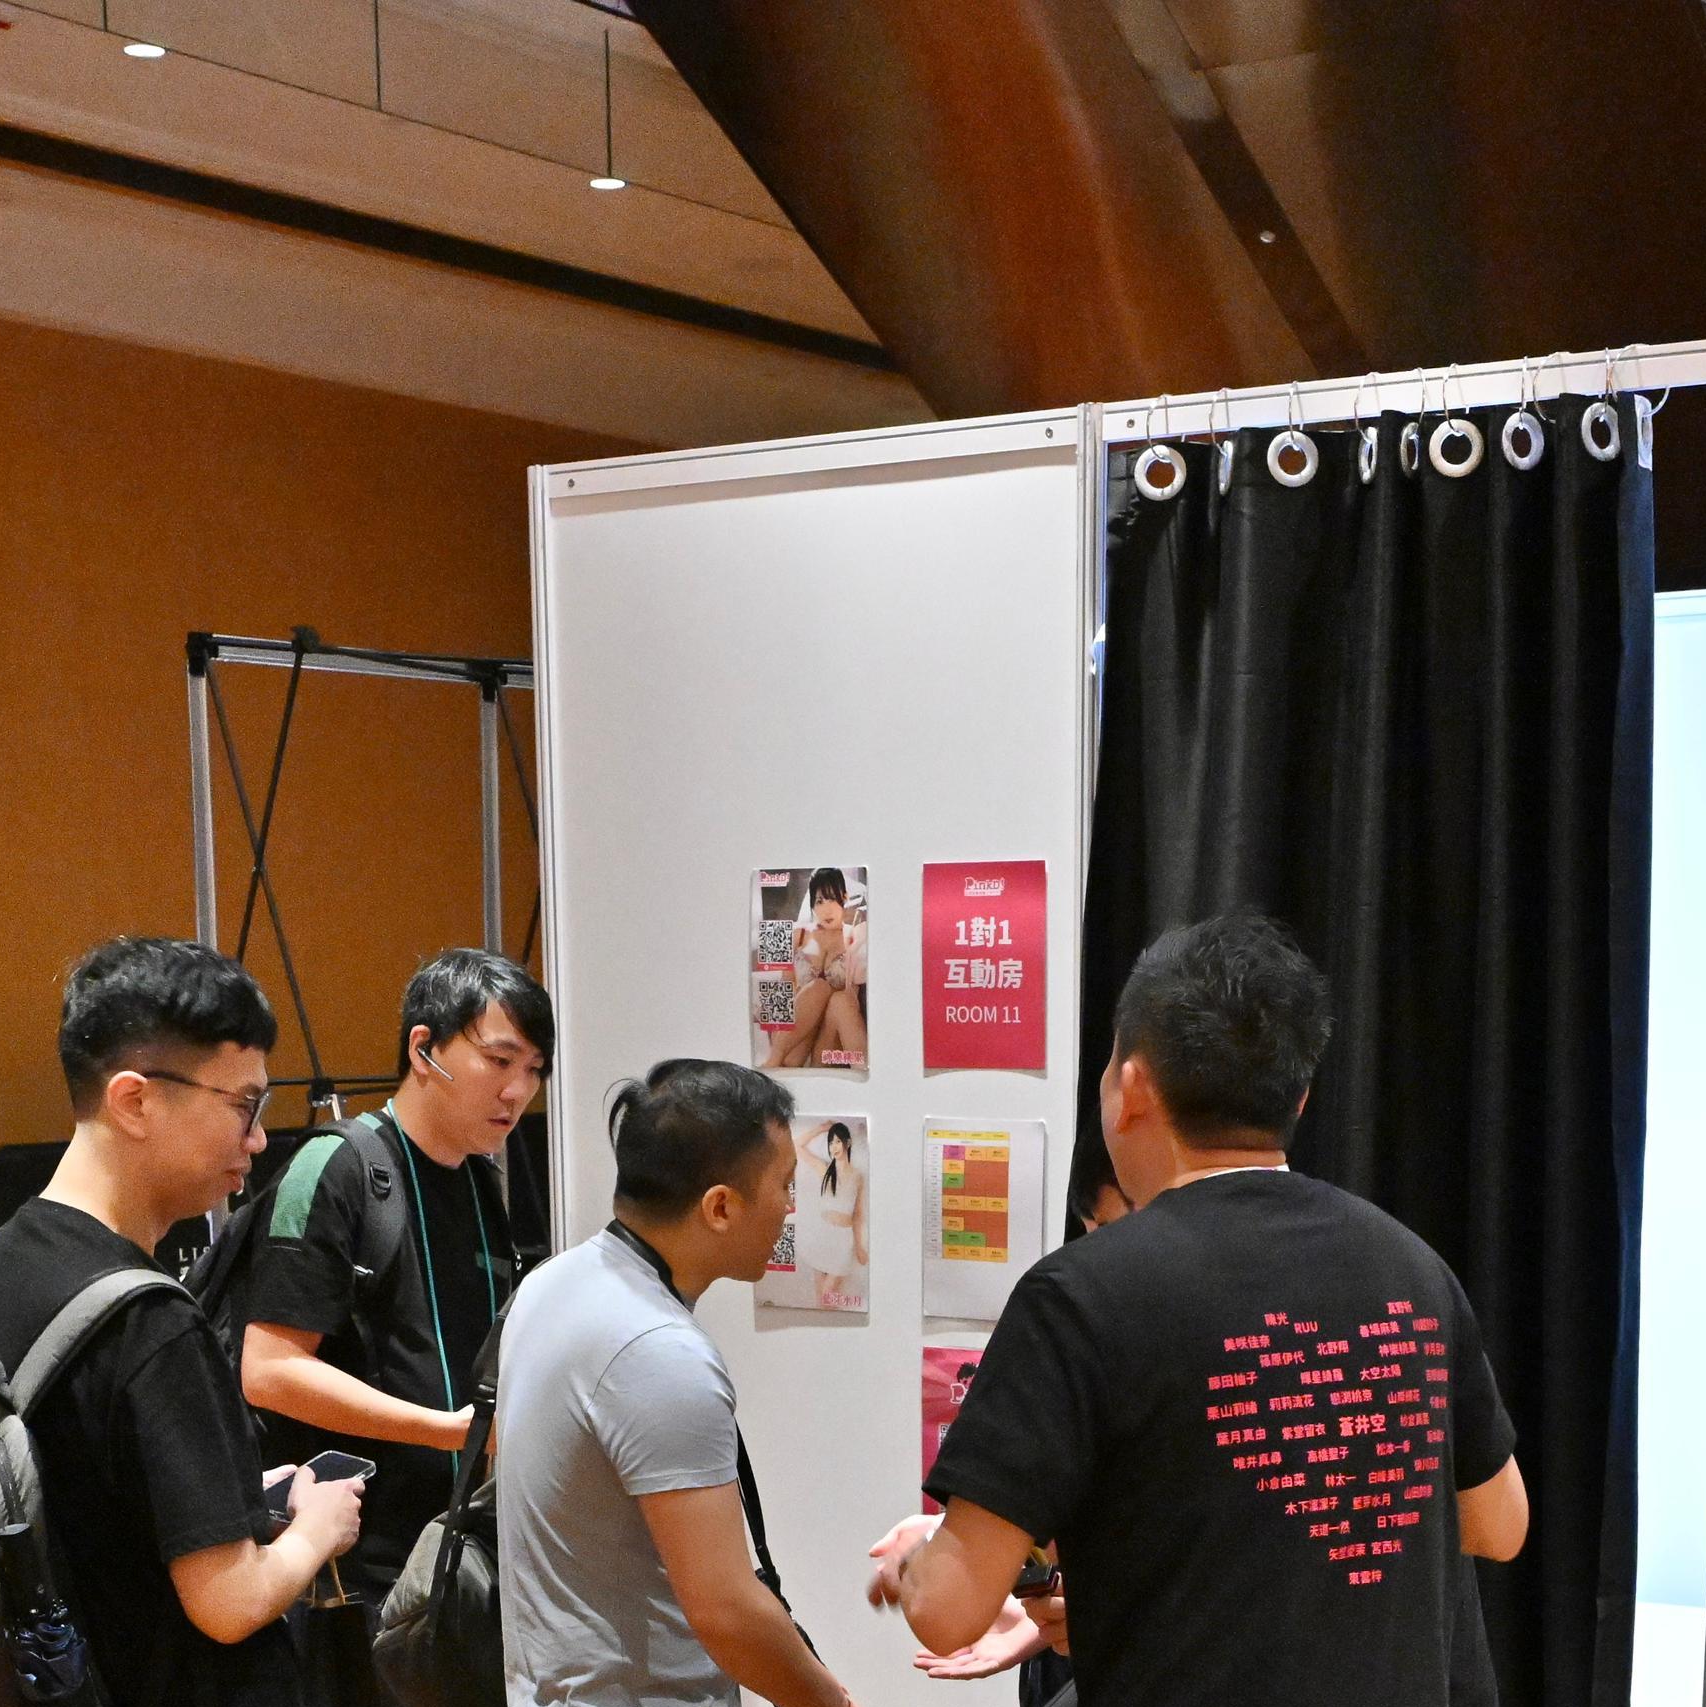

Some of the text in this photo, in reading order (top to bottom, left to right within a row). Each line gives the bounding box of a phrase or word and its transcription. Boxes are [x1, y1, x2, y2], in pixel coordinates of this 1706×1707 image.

[955, 917, 1012, 948] 1對1
[944, 959, 1023, 989] 互動房
[946, 1006, 1021, 1023] ROOM 11
[1294, 1322, 1318, 1333] RUU
[1340, 1414, 1386, 1437] 蒼井空
